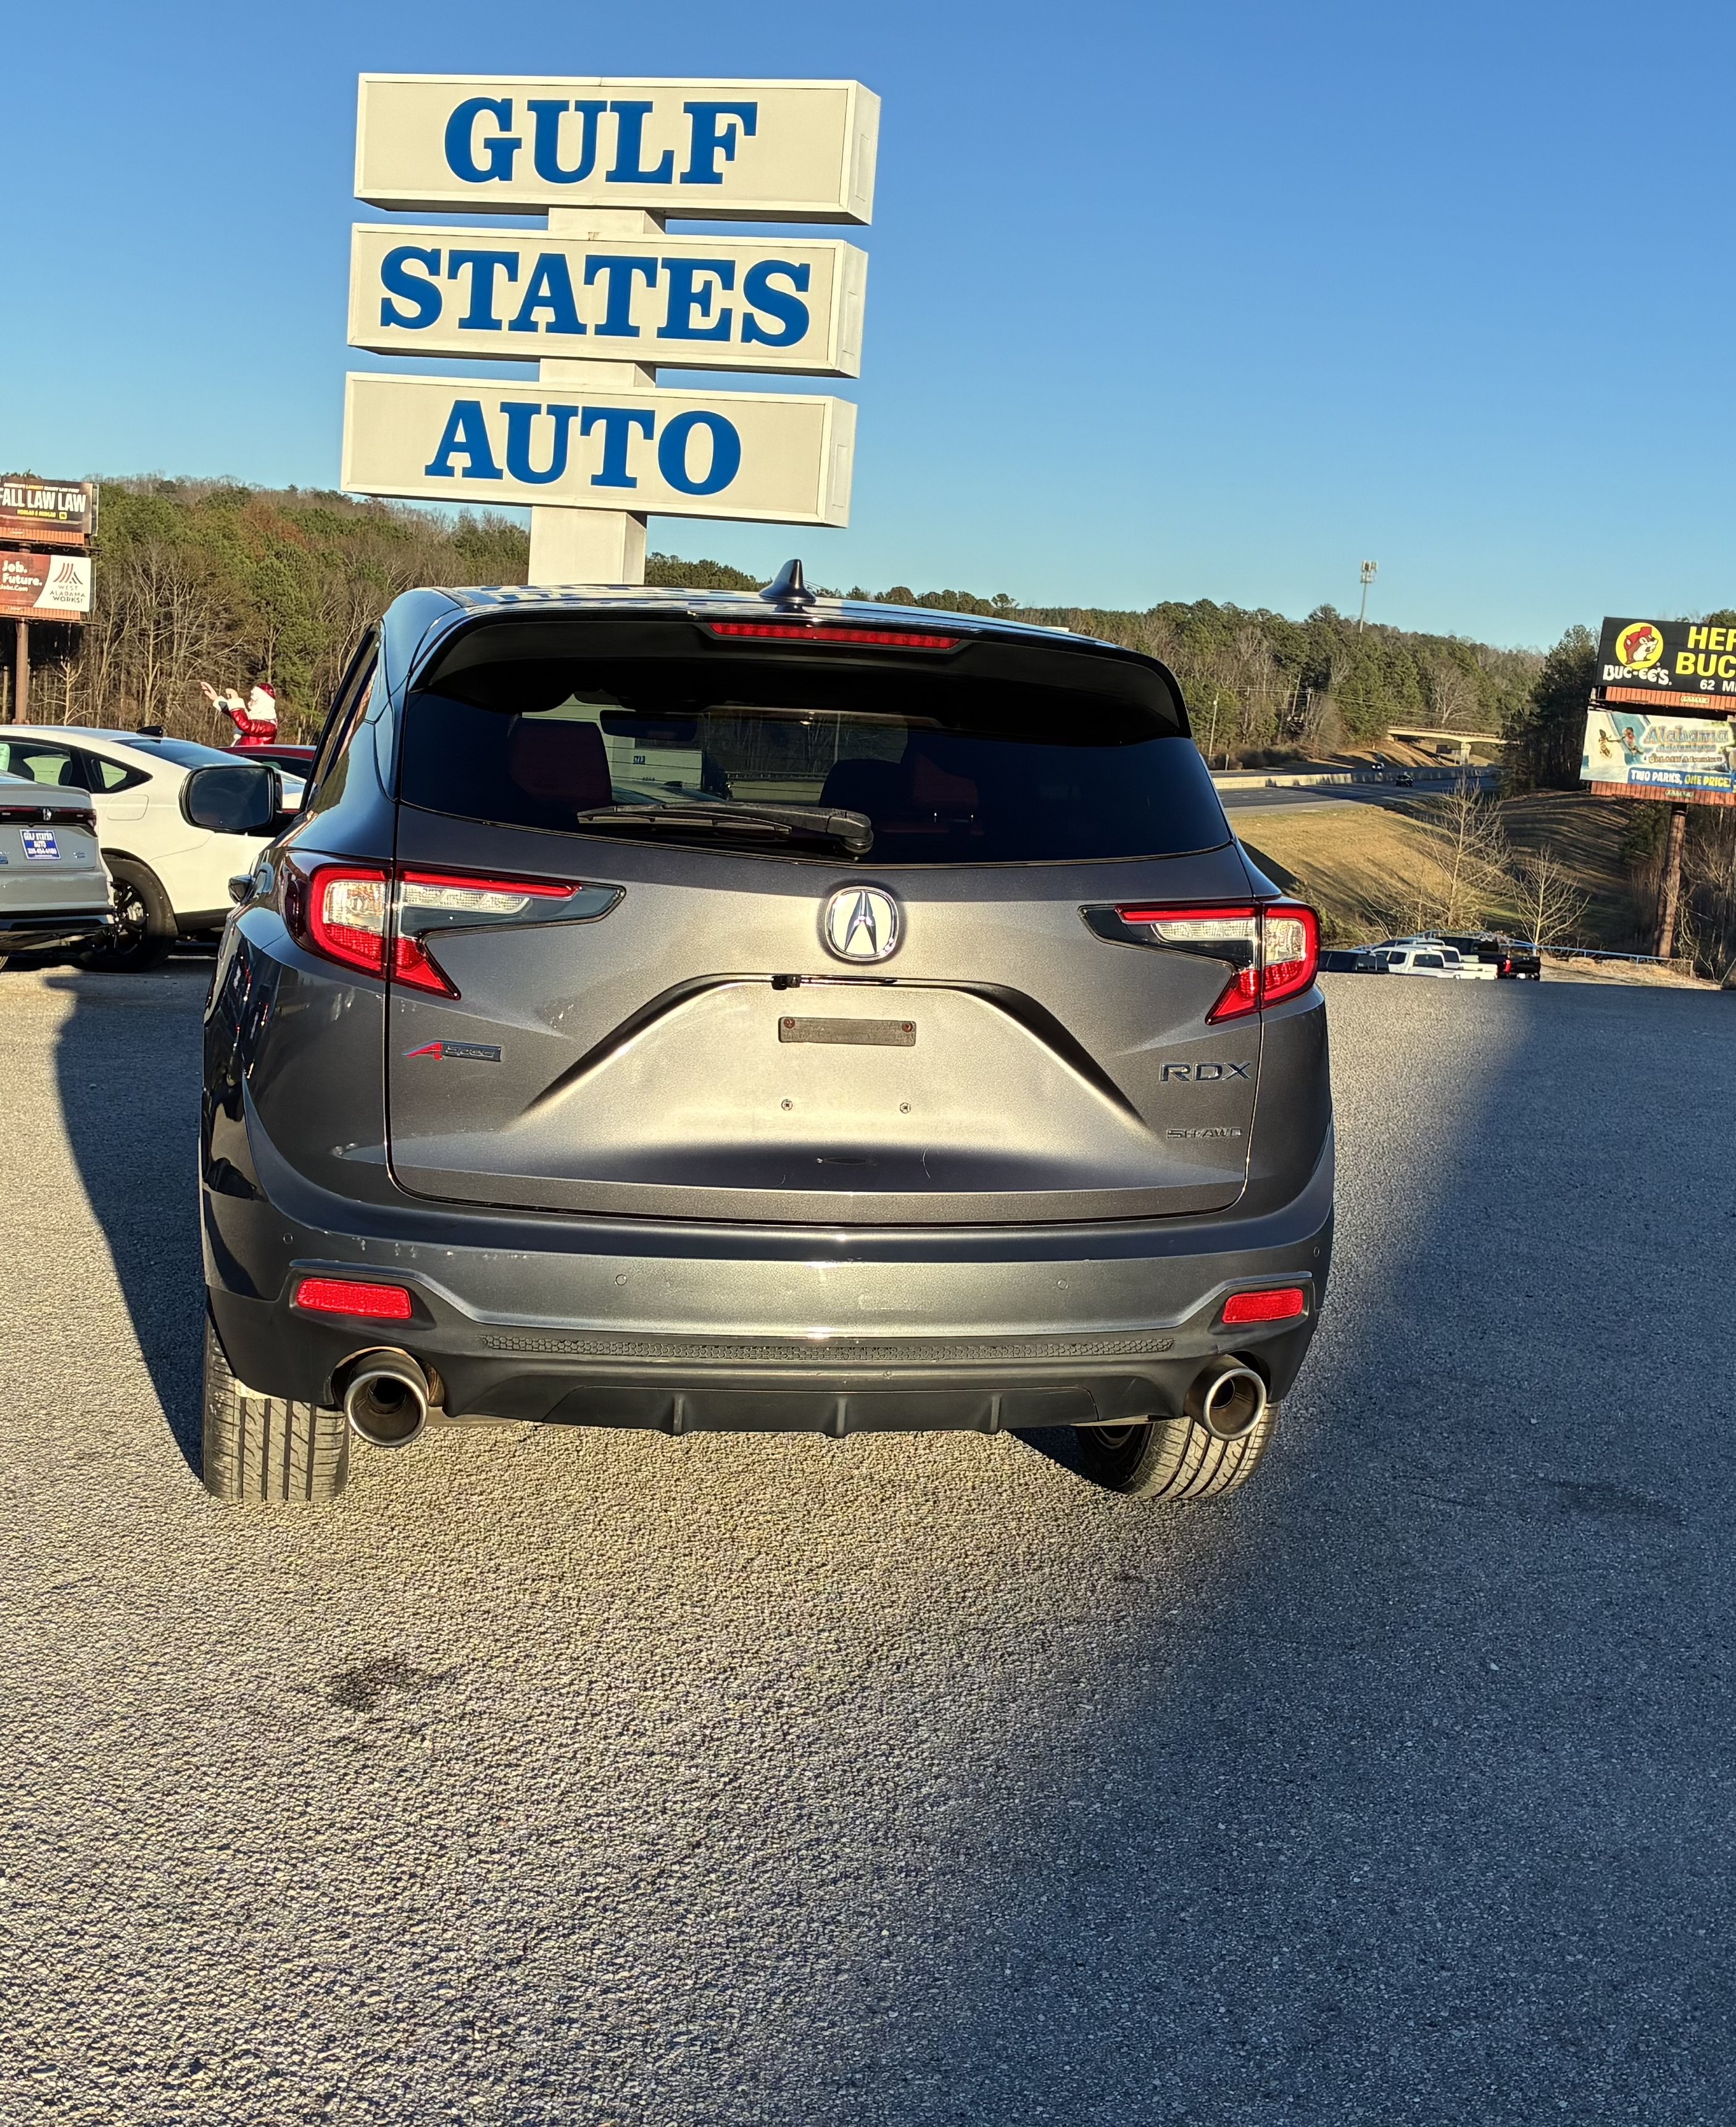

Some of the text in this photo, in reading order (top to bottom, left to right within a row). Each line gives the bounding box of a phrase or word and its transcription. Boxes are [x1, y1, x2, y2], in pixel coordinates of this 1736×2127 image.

[444, 97, 758, 185] GULF
[380, 245, 810, 348] STATES
[423, 399, 742, 497] AUTO
[27, 490, 56, 510] LAW
[57, 493, 86, 513] LAW
[2, 560, 28, 573] Job.
[2, 572, 43, 586] Future.
[1700, 679, 1716, 691] 62
[1643, 725, 1729, 744] Alabama
[1630, 770, 1651, 781] TWO
[1652, 771, 1683, 785] PARKS,
[1684, 775, 1702, 785] ONE
[1159, 1061, 1252, 1081] RDX
